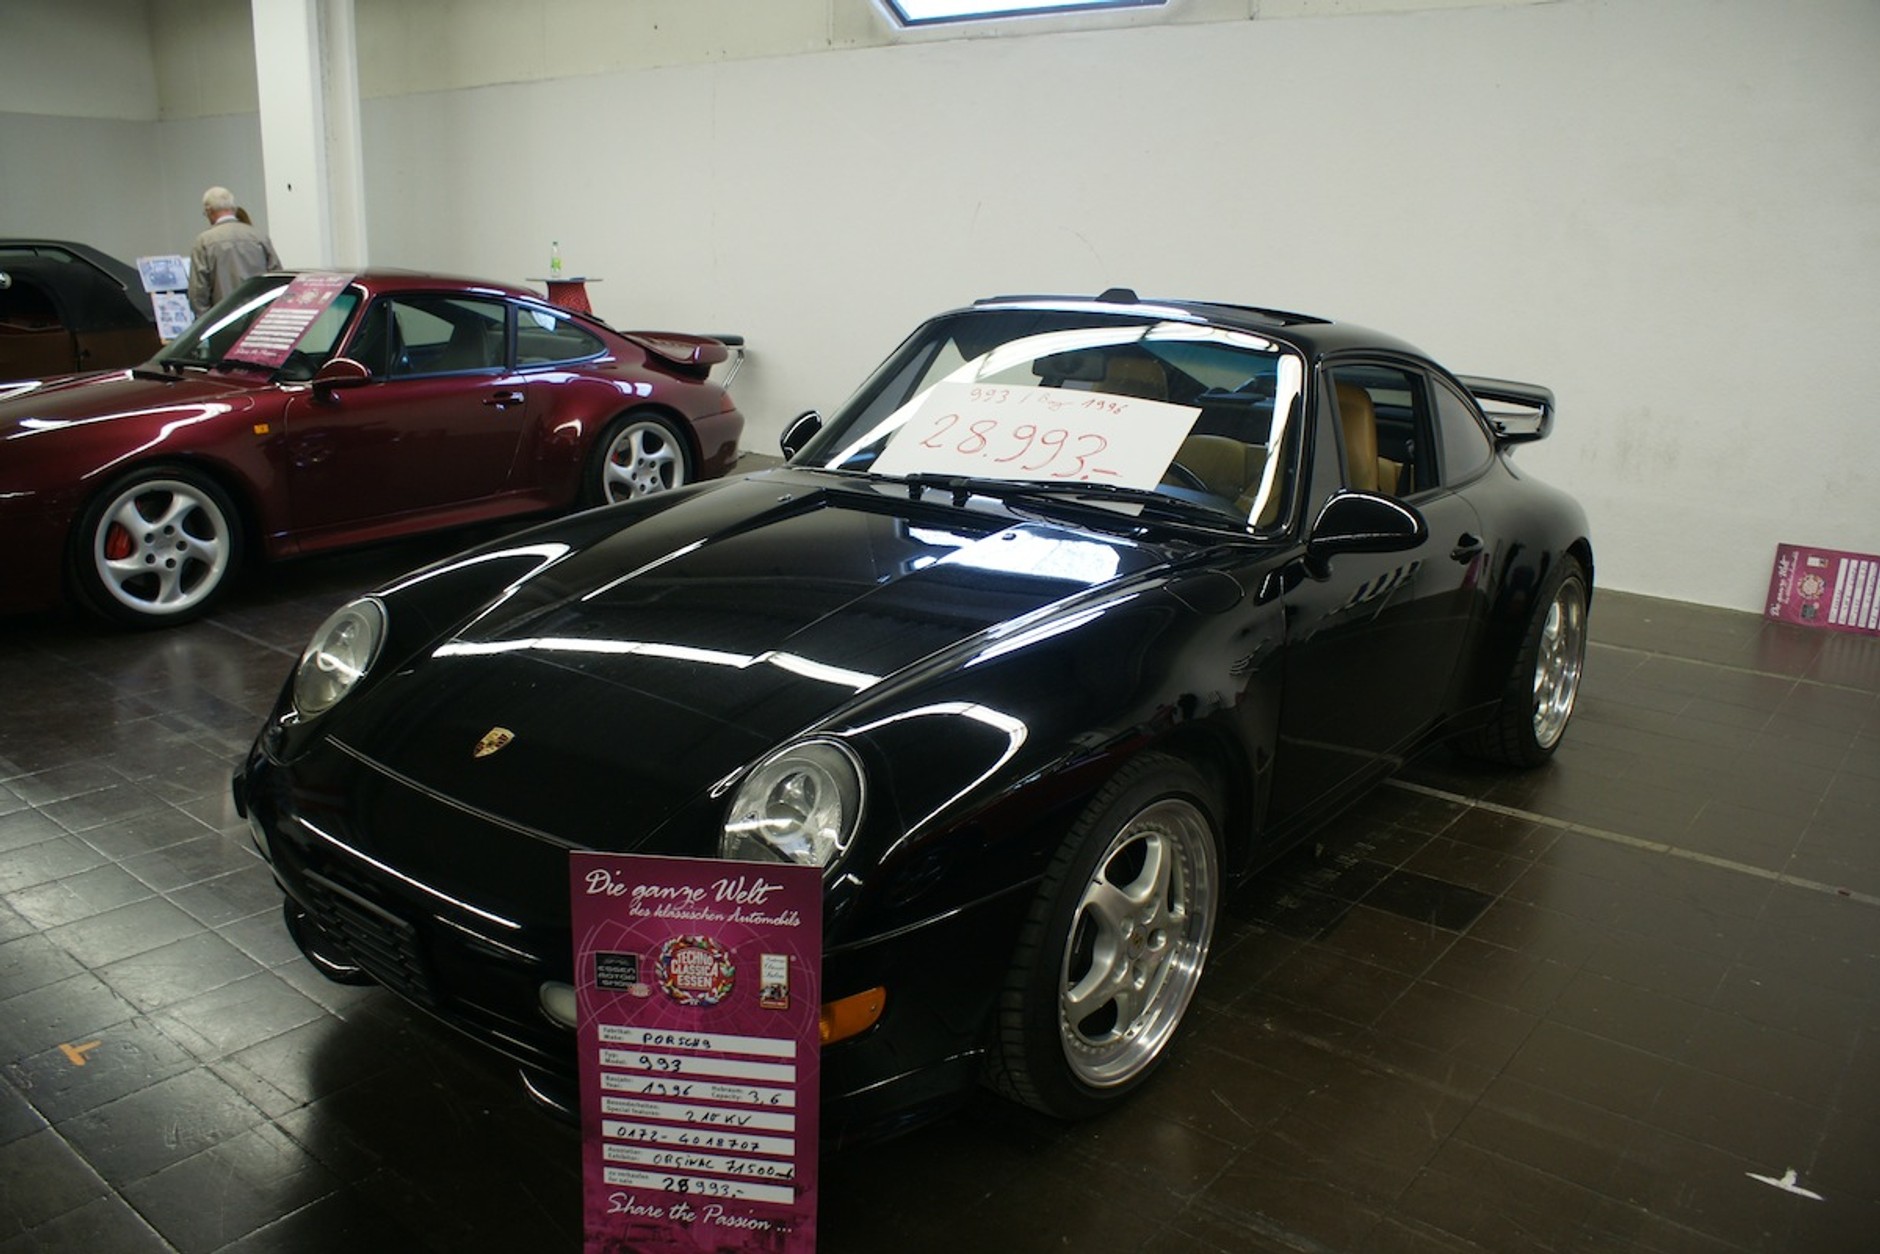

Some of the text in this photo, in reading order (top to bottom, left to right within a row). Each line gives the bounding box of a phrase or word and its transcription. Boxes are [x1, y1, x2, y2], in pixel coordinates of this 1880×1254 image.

[969, 387, 1010, 404] 993
[585, 868, 785, 911] Die ganze Welt
[629, 902, 801, 927] des klassischen Automobils
[676, 950, 714, 966] TECHNO
[670, 959, 719, 977] CLASSICA
[677, 975, 713, 988] ESSEN
[639, 1055, 682, 1073] 993
[748, 1090, 782, 1105] 3,6
[617, 1126, 759, 1151] 0172- 4018707
[607, 1192, 664, 1218] Share
[669, 1202, 697, 1222] the
[702, 1204, 772, 1231] Passion
